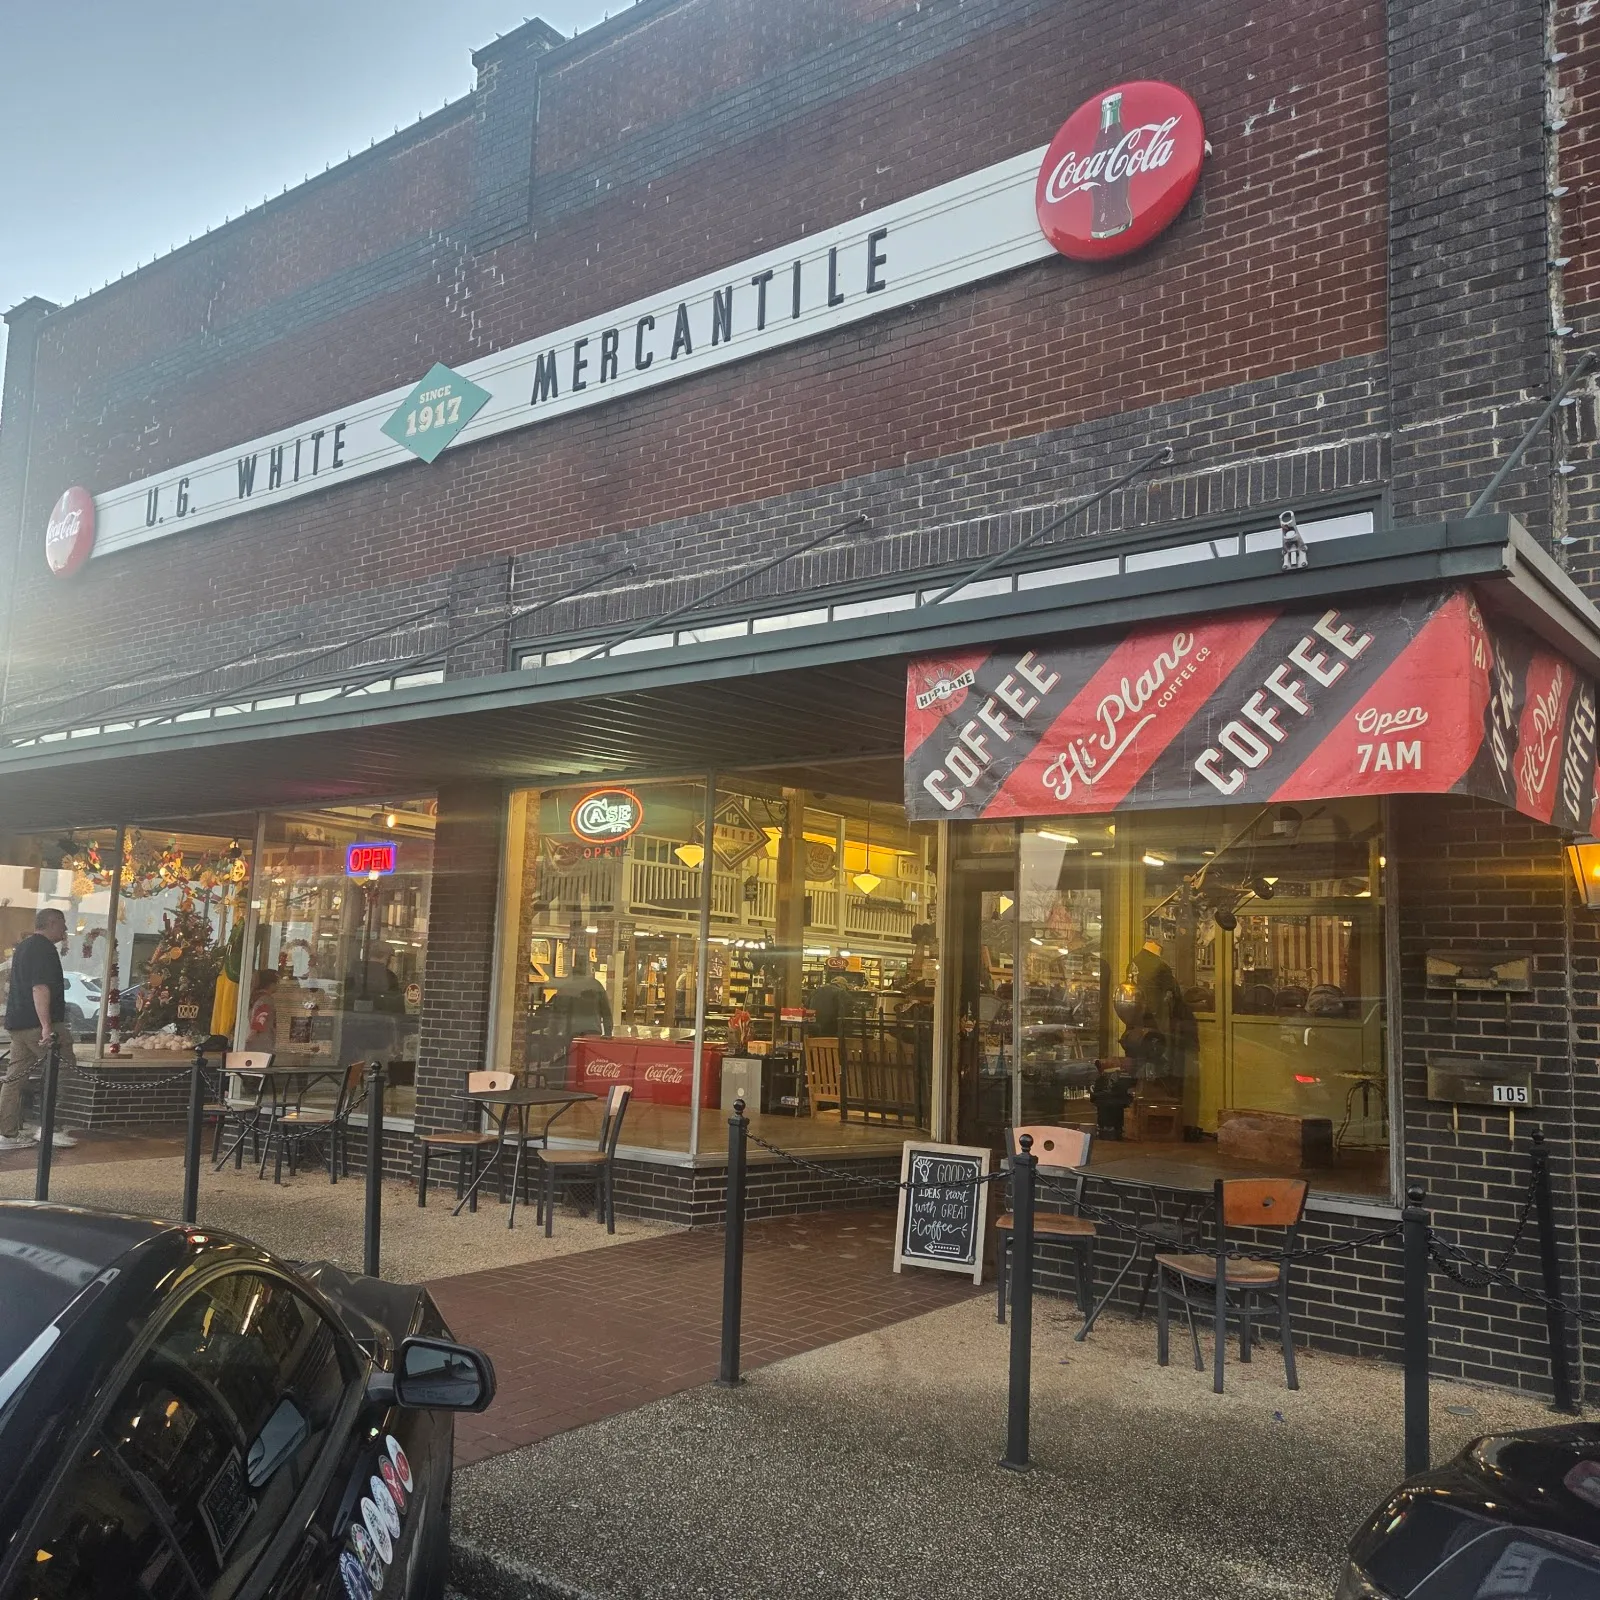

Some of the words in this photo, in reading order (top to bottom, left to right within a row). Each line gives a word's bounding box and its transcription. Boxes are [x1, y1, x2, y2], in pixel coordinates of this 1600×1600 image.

[1045, 115, 1182, 203] Coca-Cola
[237, 422, 347, 500] WHITE
[530, 227, 888, 406] MERCANTILE
[419, 384, 452, 404] SINCE
[405, 396, 463, 437] 1917
[919, 672, 973, 707] HI-PLANE
[1157, 662, 1198, 709] COFFEE
[1041, 631, 1195, 801] Hi-Plane
[1194, 608, 1375, 796] COFFEE
[923, 650, 1061, 811] COFFEE
[1354, 706, 1429, 736] Open
[1356, 740, 1422, 774] 7AM
[1562, 682, 1596, 823] COFFEE
[577, 797, 633, 834] CASE
[725, 812, 740, 826] UG
[349, 847, 393, 871] OPEN
[583, 846, 622, 859] OPEN
[586, 1060, 622, 1078] Coca-Cola
[645, 1065, 685, 1084] Coca-Cola
[1496, 1087, 1526, 1102] 105
[936, 1164, 966, 1183] GOOD
[918, 1187, 941, 1200] IDEAS
[945, 1189, 970, 1203] start
[914, 1201, 937, 1218] with
[941, 1203, 969, 1220] GREAT
[917, 1218, 962, 1241] Coffee
